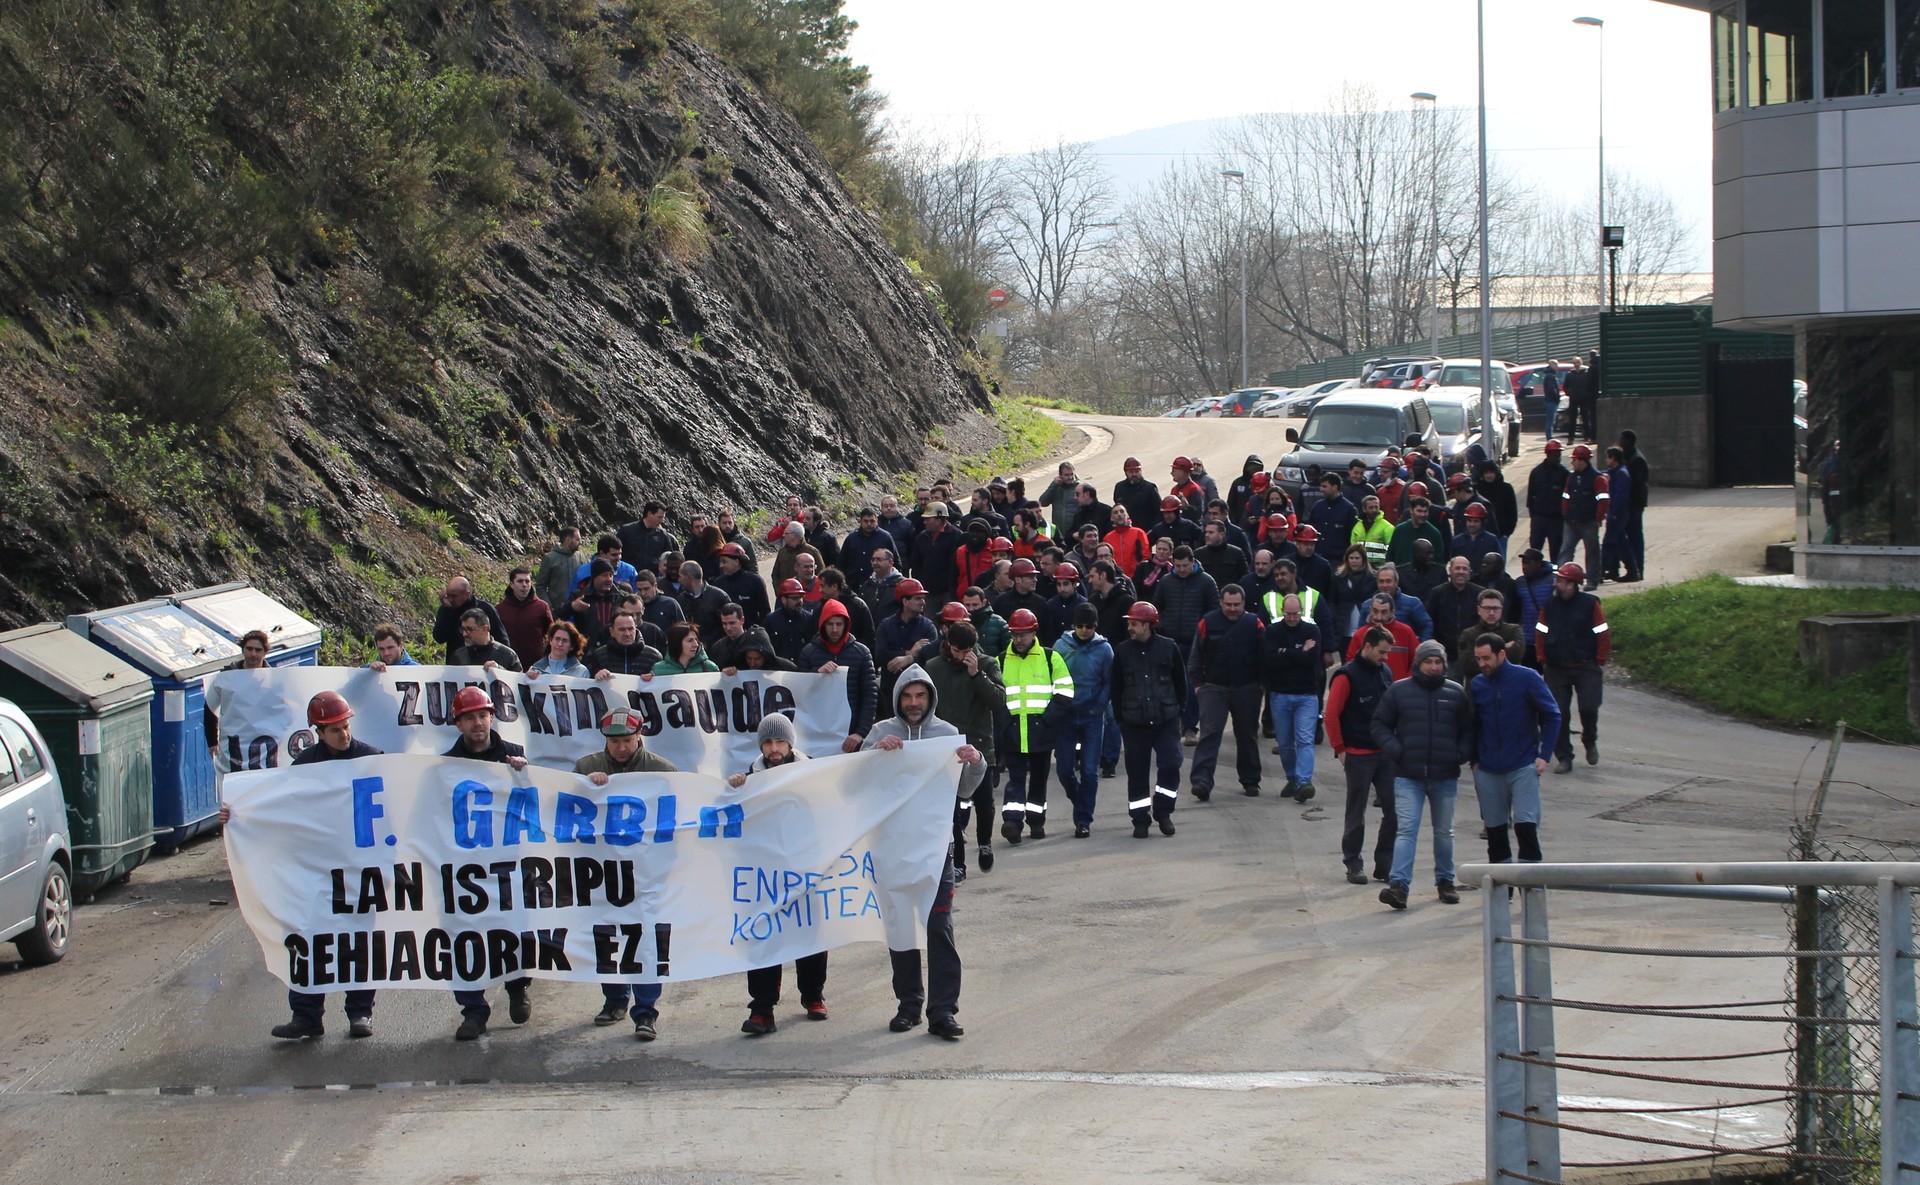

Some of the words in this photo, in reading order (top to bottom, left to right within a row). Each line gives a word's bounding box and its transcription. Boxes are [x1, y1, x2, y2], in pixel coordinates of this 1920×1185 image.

[395, 679, 610, 738] zuekin
[627, 680, 796, 737] gaude
[352, 776, 397, 849] F.
[330, 861, 424, 915] LAN
[441, 856, 636, 915] ISTRIPU
[730, 886, 882, 945] KOMITEA
[284, 927, 572, 987] GEHIAGORIK
